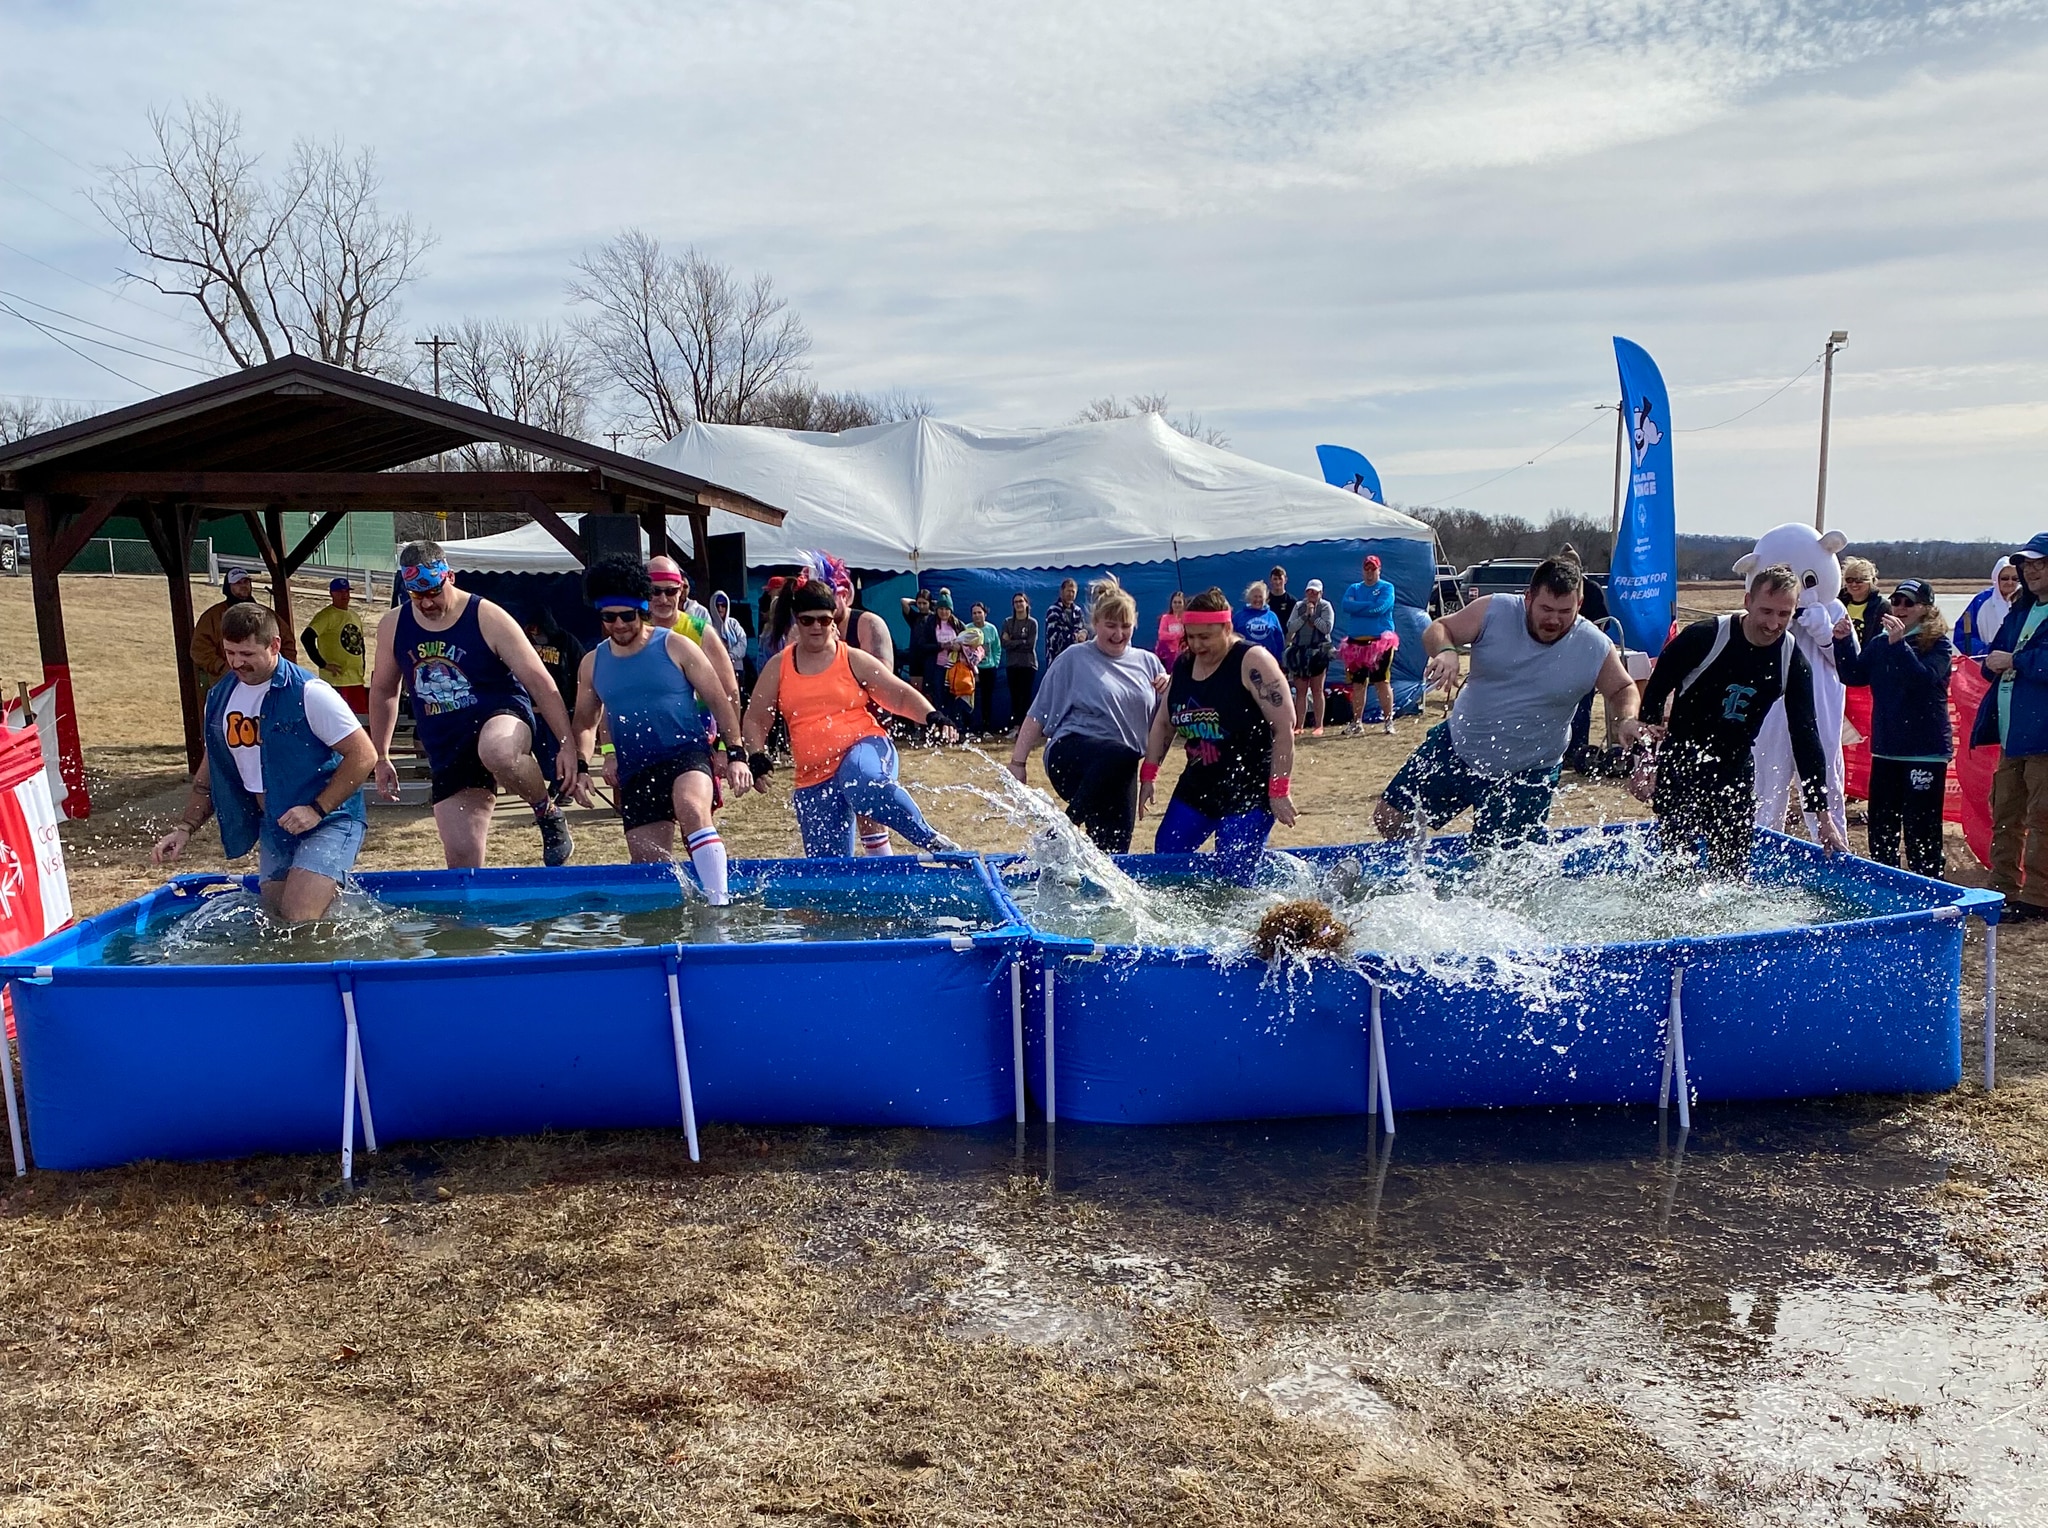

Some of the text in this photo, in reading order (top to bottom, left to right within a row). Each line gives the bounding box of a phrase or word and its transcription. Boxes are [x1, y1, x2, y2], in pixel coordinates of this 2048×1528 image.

[1650, 572, 1668, 583] FOR
[1619, 587, 1660, 600] A REASON
[407, 640, 467, 664] I SWEAT
[1722, 684, 1757, 722] E
[1180, 712, 1193, 723] GET
